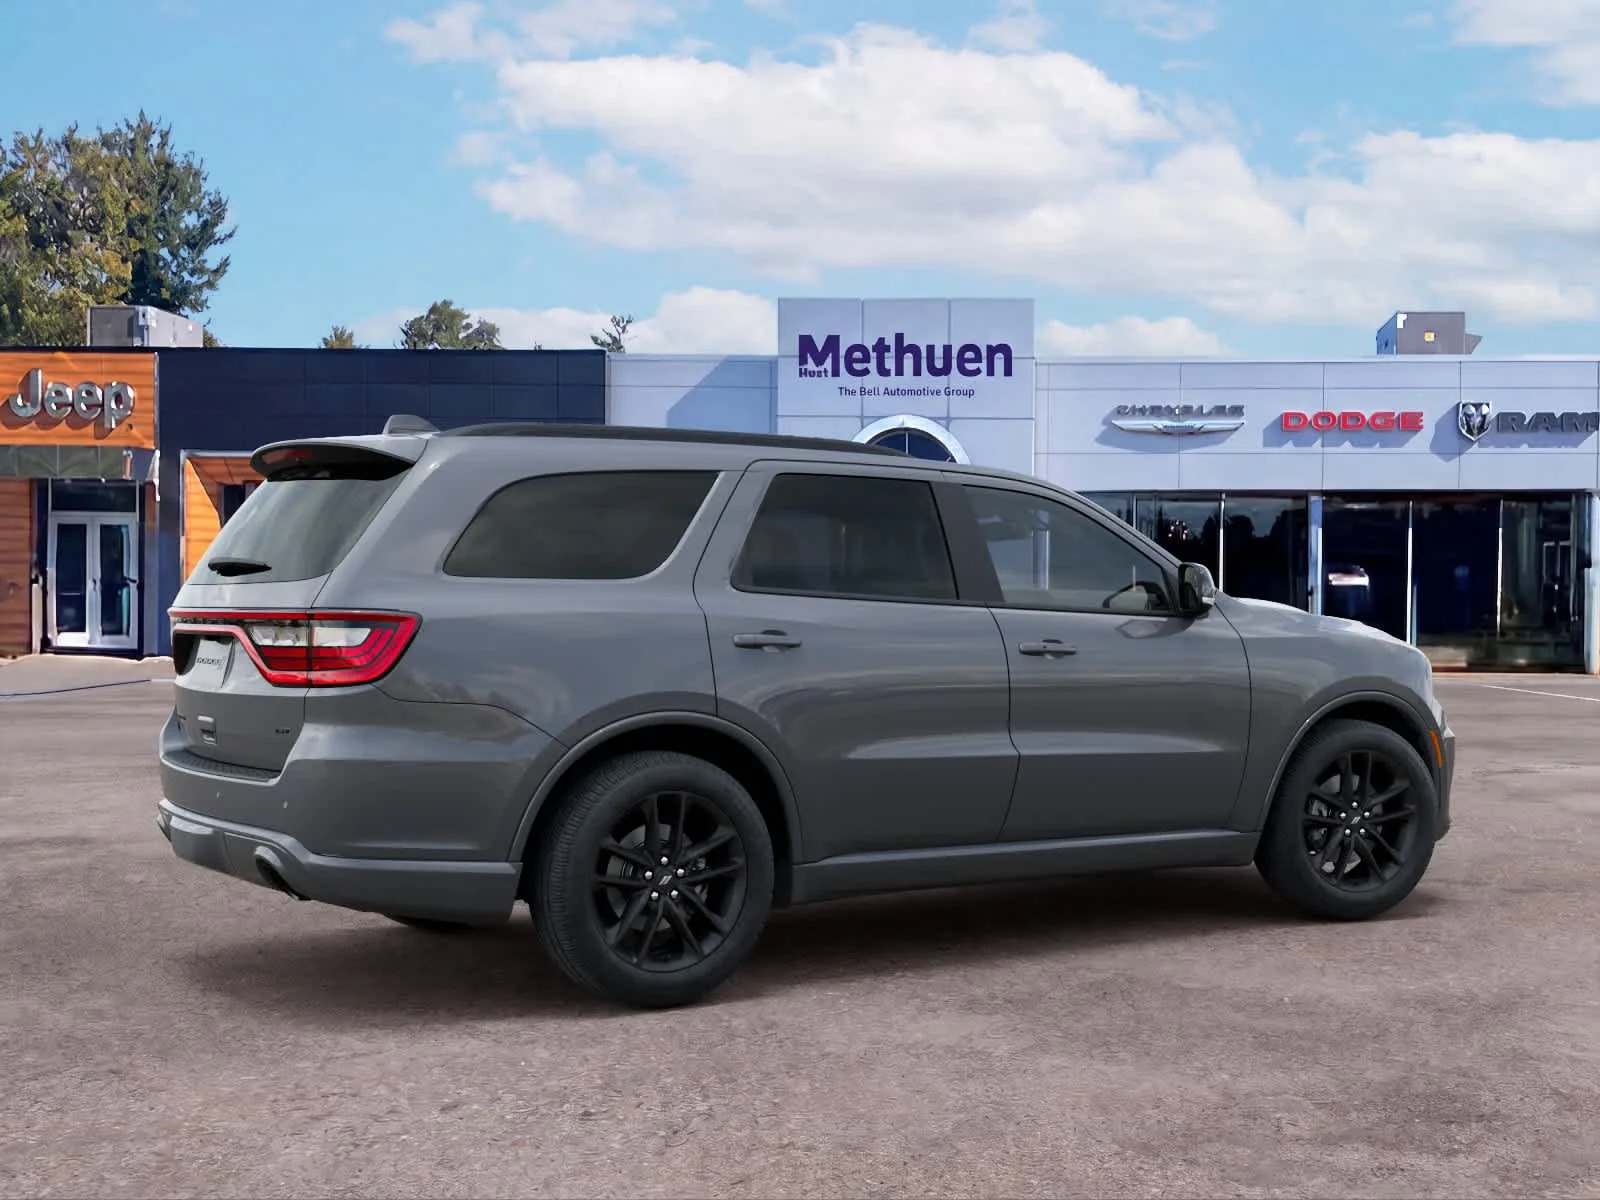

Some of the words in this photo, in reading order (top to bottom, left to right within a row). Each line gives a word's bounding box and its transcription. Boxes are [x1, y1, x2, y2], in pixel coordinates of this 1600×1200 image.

[798, 333, 1012, 377] Methuen
[9, 368, 136, 429] Jeep
[838, 386, 857, 396] The
[859, 386, 880, 396] Bell
[883, 386, 941, 397] Automotive
[944, 386, 975, 399] Group
[1282, 411, 1425, 432] DODGE
[1497, 411, 1600, 433] RAM
